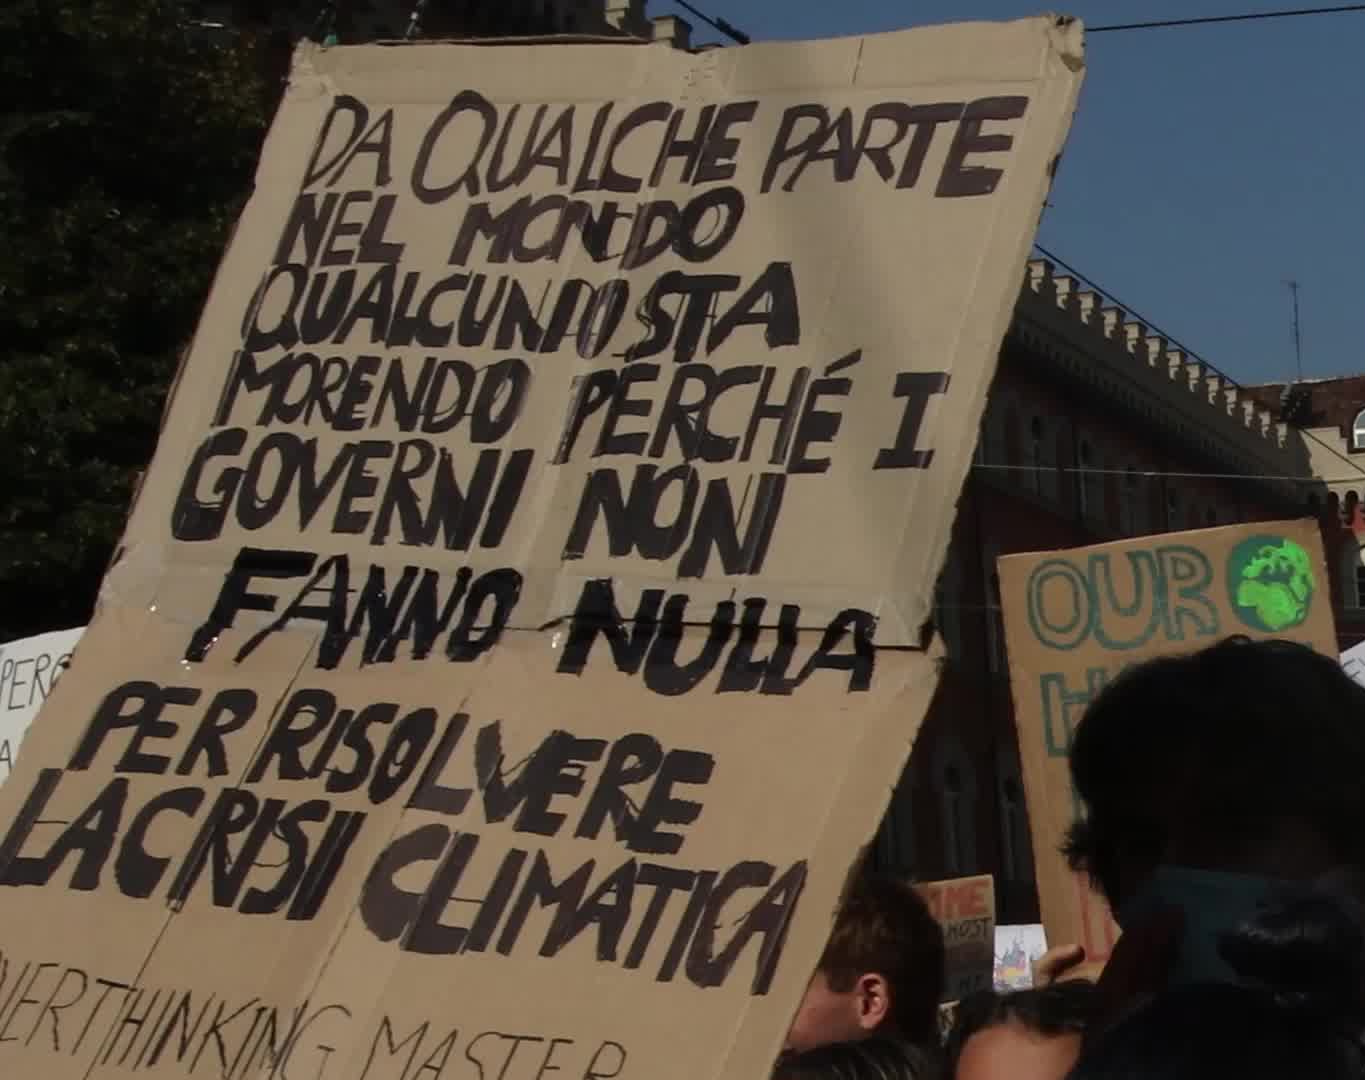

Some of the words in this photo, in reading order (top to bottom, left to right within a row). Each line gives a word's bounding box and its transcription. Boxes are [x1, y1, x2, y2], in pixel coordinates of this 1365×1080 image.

[302, 94, 392, 190] DA
[411, 89, 758, 204] QUALCHE
[760, 94, 1030, 198] PARTE
[274, 192, 405, 267] NEL
[447, 185, 745, 270] MONDO
[242, 263, 629, 360] QUALCUNO
[624, 261, 800, 363] STA
[210, 355, 535, 446] MORENDO
[553, 348, 864, 475] PERCHÉ
[872, 371, 952, 471] I
[171, 427, 535, 552] GOVERNI
[183, 546, 524, 670] FANNO
[556, 577, 878, 696] NULLA
[1025, 543, 1220, 650] OUR
[67, 680, 259, 777] PER
[245, 687, 715, 855] RISOLVERE
[359, 822, 808, 997] CLIMATICA
